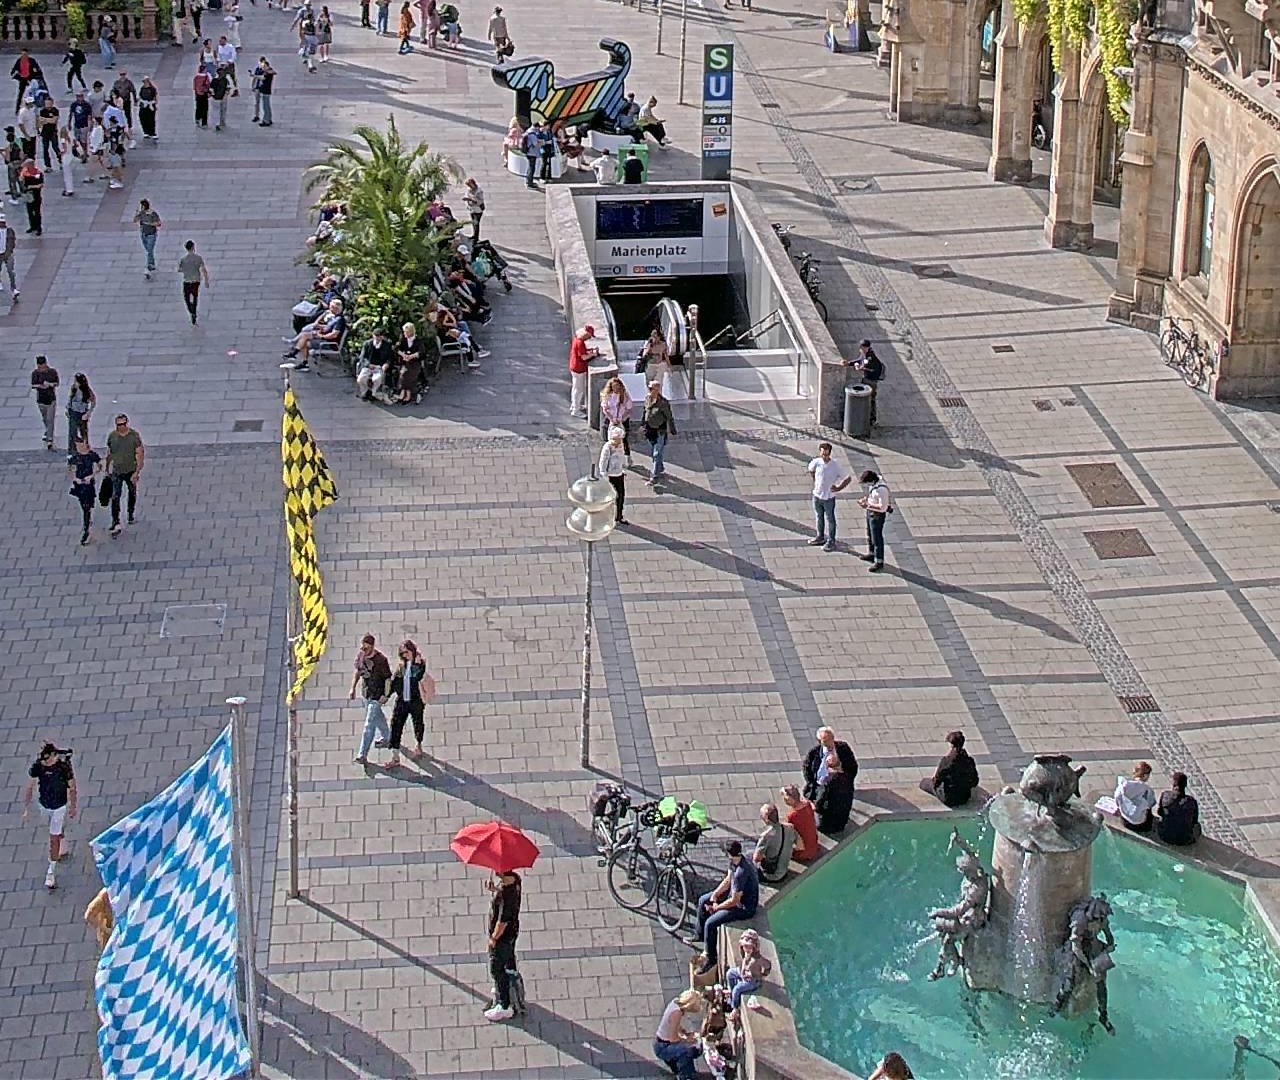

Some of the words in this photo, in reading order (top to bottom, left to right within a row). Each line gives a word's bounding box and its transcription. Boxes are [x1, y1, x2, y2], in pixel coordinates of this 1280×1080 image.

[709, 47, 728, 69] S
[709, 75, 727, 97] U
[611, 244, 687, 259] Marienplatz
